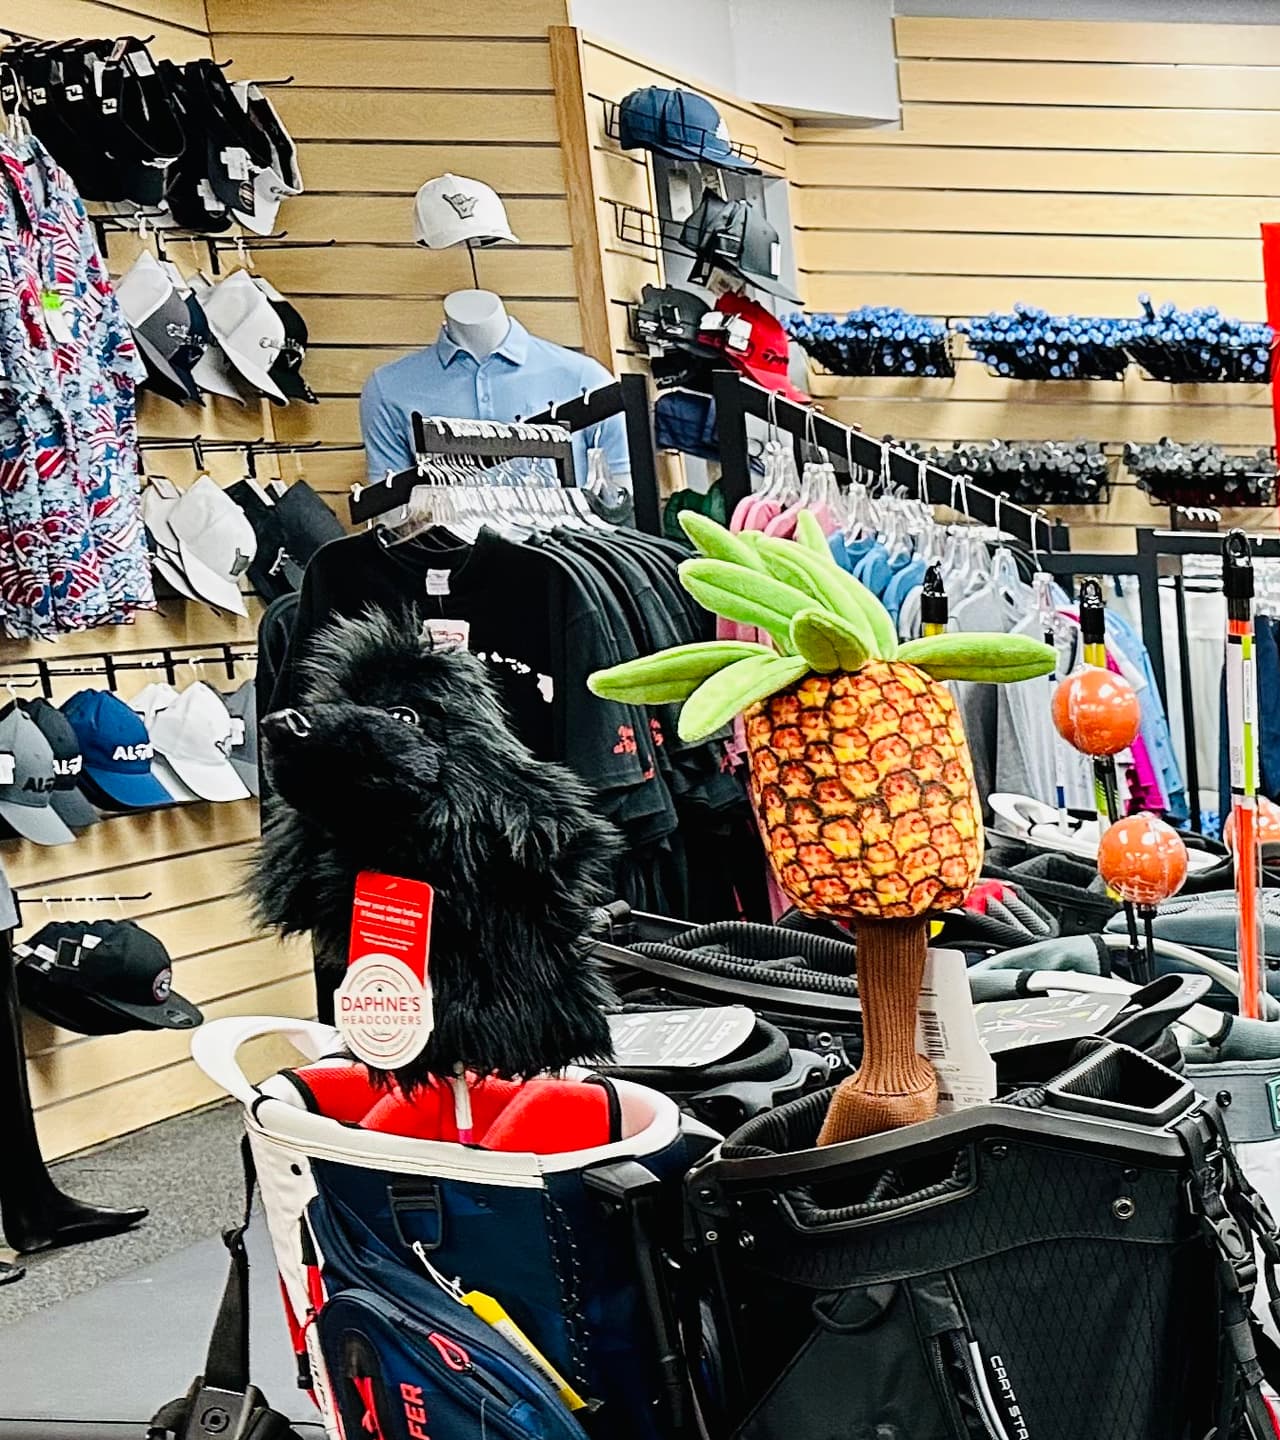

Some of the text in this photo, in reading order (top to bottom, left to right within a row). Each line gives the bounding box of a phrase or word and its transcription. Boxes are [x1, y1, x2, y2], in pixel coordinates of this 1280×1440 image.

[340, 996, 421, 1012] DAPHNE'S
[341, 1015, 422, 1026] HEADCOVERS
[988, 1353, 1016, 1400] CART
